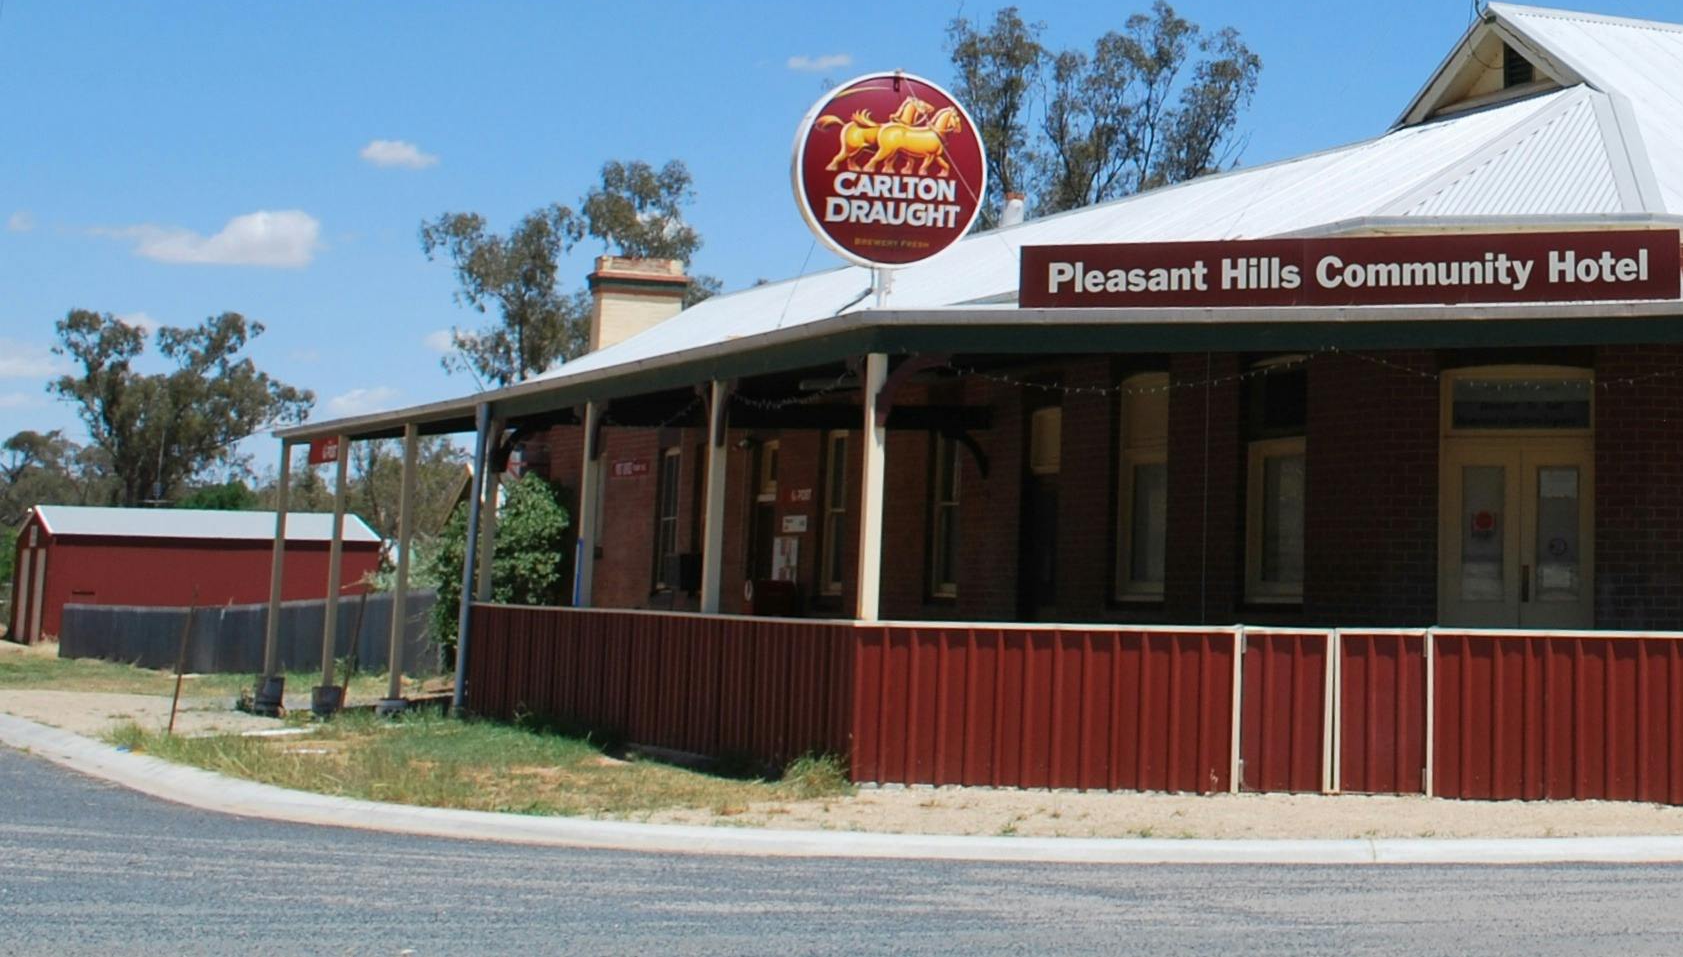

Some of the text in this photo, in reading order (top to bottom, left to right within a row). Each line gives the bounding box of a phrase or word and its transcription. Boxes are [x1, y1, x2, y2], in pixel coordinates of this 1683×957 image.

[834, 171, 957, 202] CARLTON
[824, 197, 961, 228] DRAUGHT
[1048, 249, 1649, 294] Pleasant Hills Community Hotel
